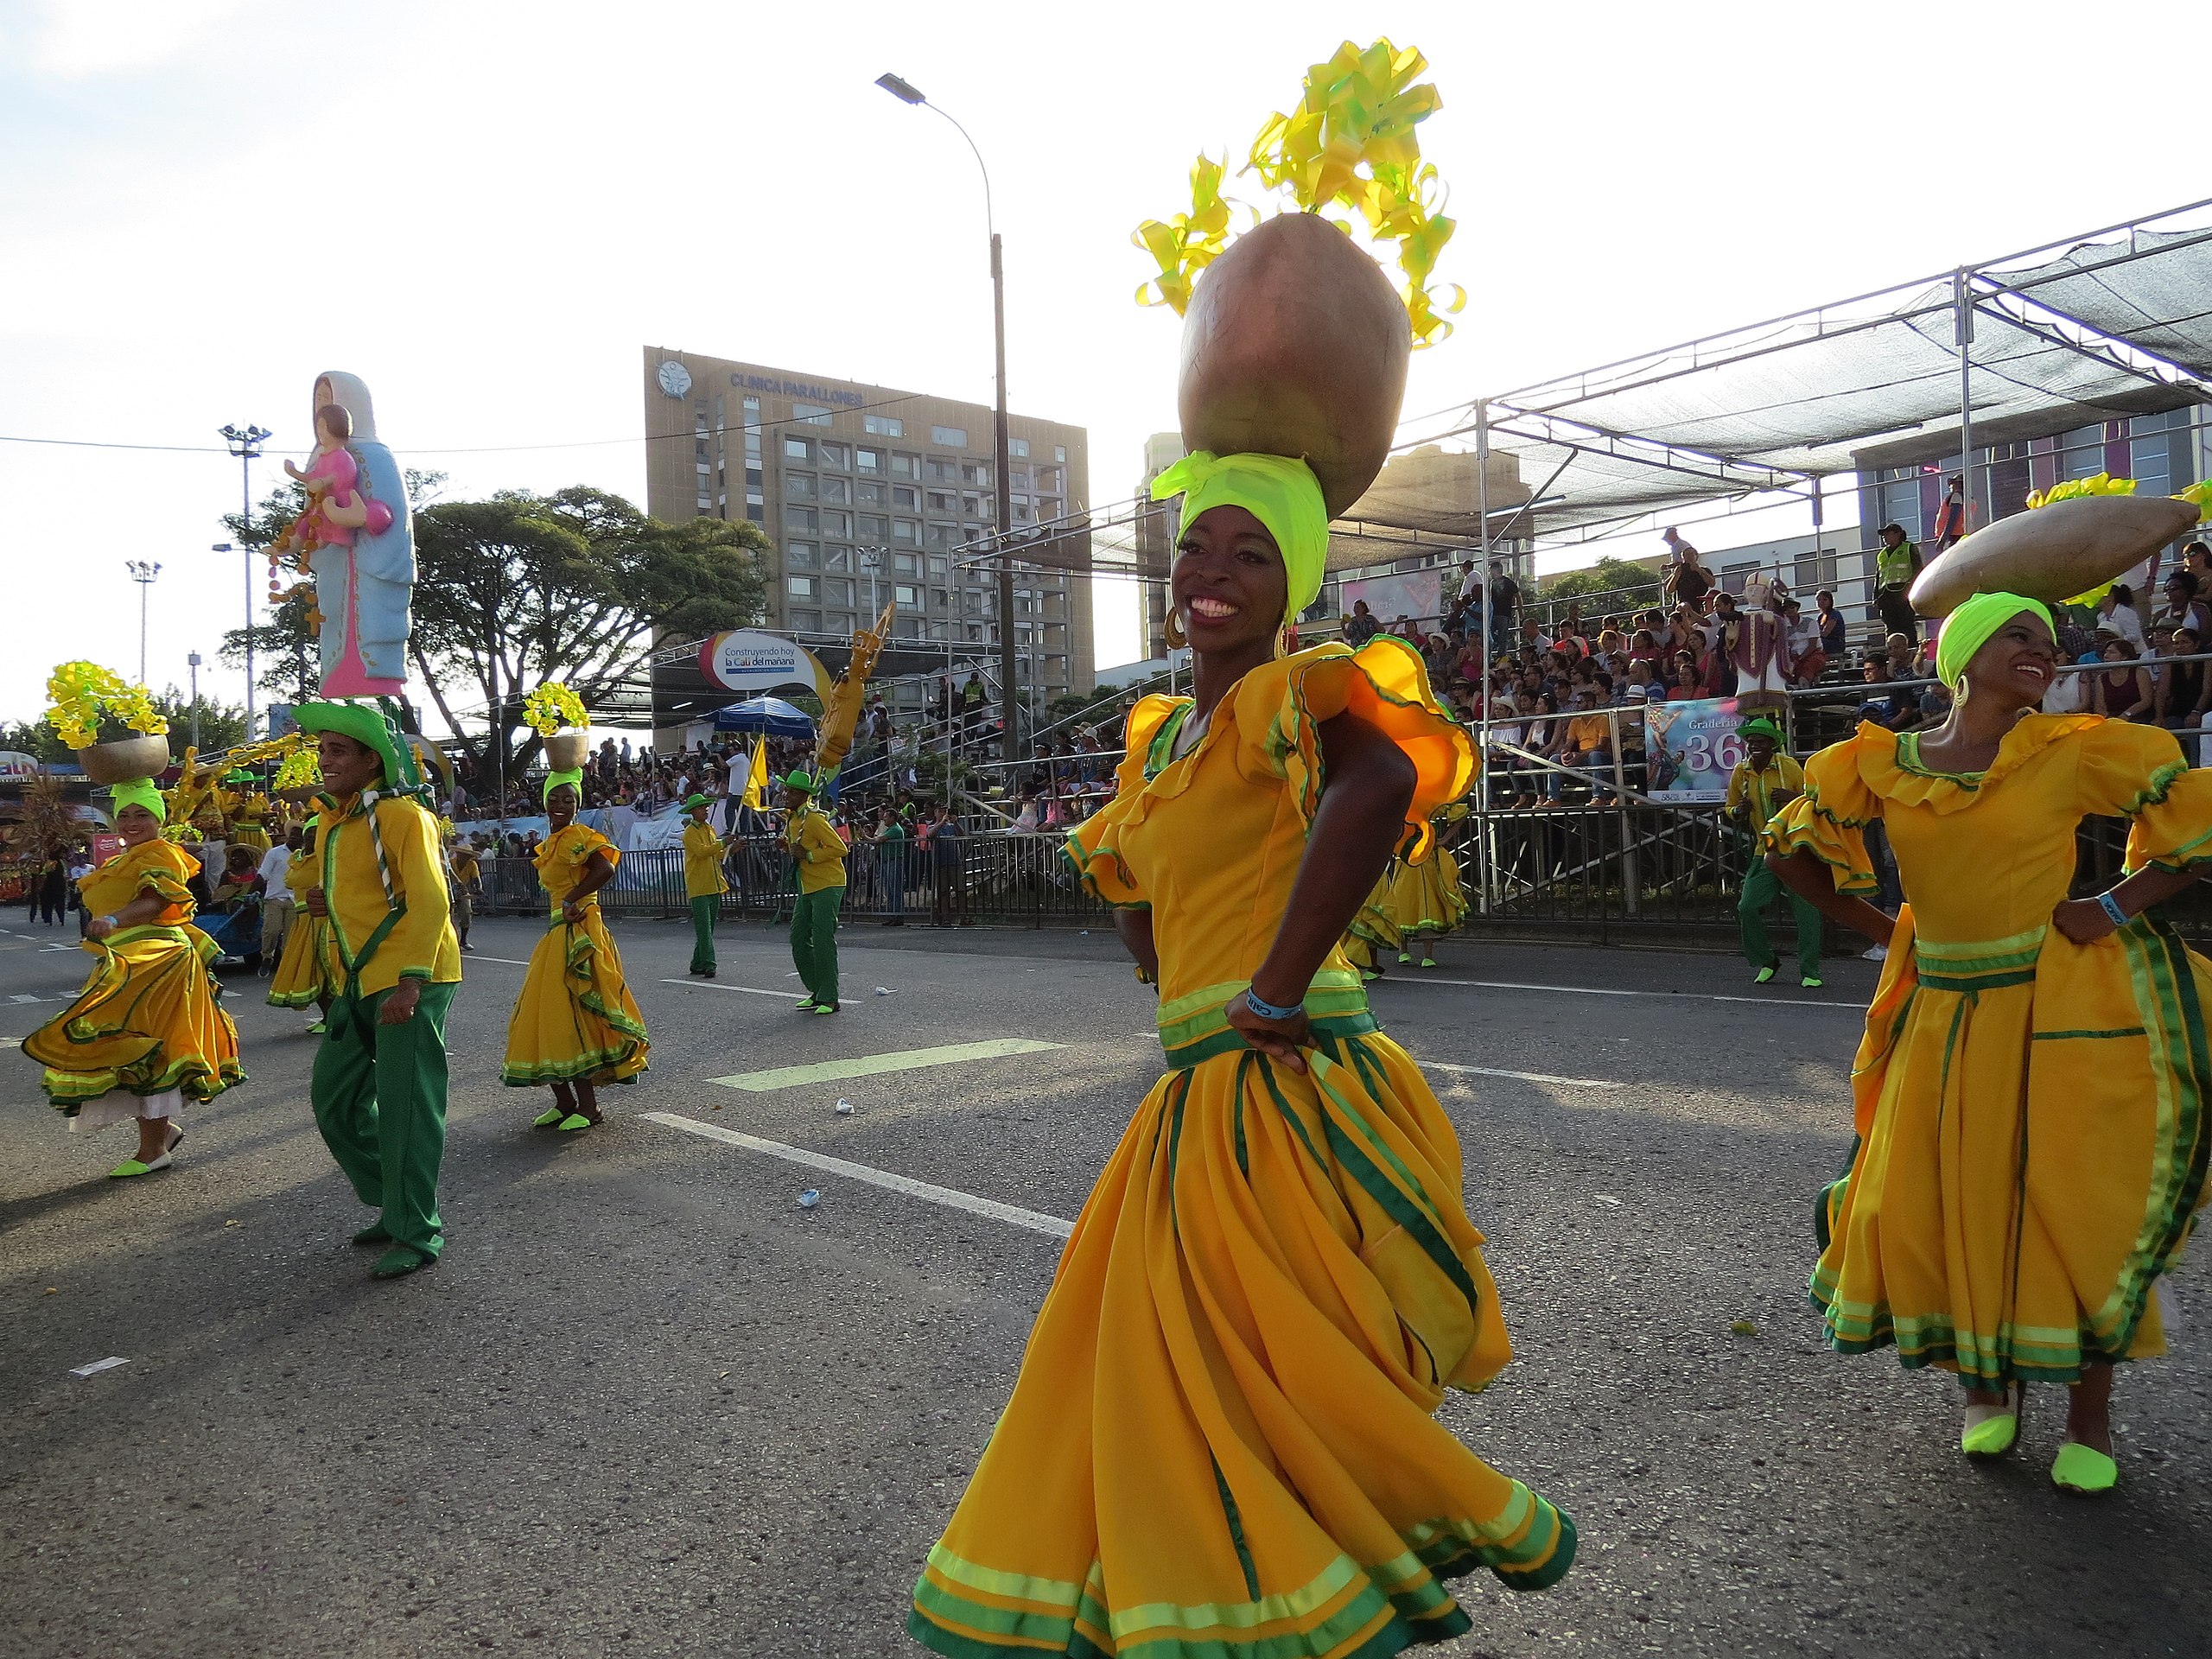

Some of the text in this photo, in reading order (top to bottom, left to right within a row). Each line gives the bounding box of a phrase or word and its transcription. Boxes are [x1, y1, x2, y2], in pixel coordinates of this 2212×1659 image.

[725, 647, 795, 658] Construyendo hoy
[734, 658, 751, 666] Cali
[752, 658, 764, 666] del
[1686, 733, 1743, 772] 36
